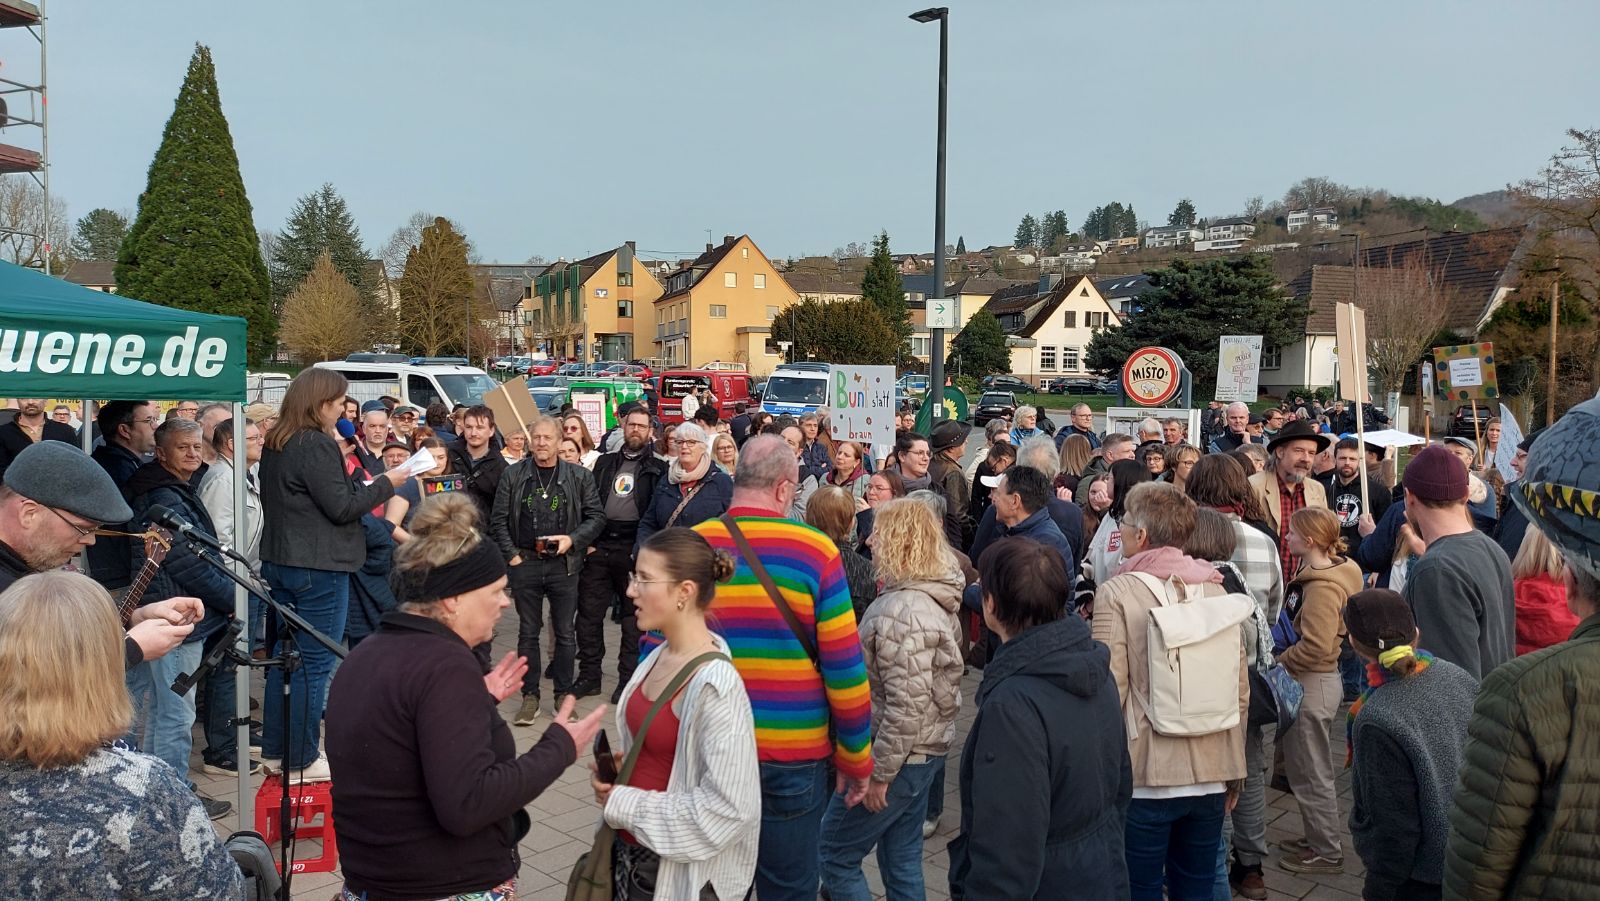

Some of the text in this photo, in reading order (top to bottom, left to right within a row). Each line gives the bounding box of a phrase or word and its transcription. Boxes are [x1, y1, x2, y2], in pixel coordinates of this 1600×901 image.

[0, 326, 228, 378] uene.de
[836, 370, 870, 409] Bunt
[848, 417, 873, 440] braun
[426, 479, 463, 493] NAZIS
